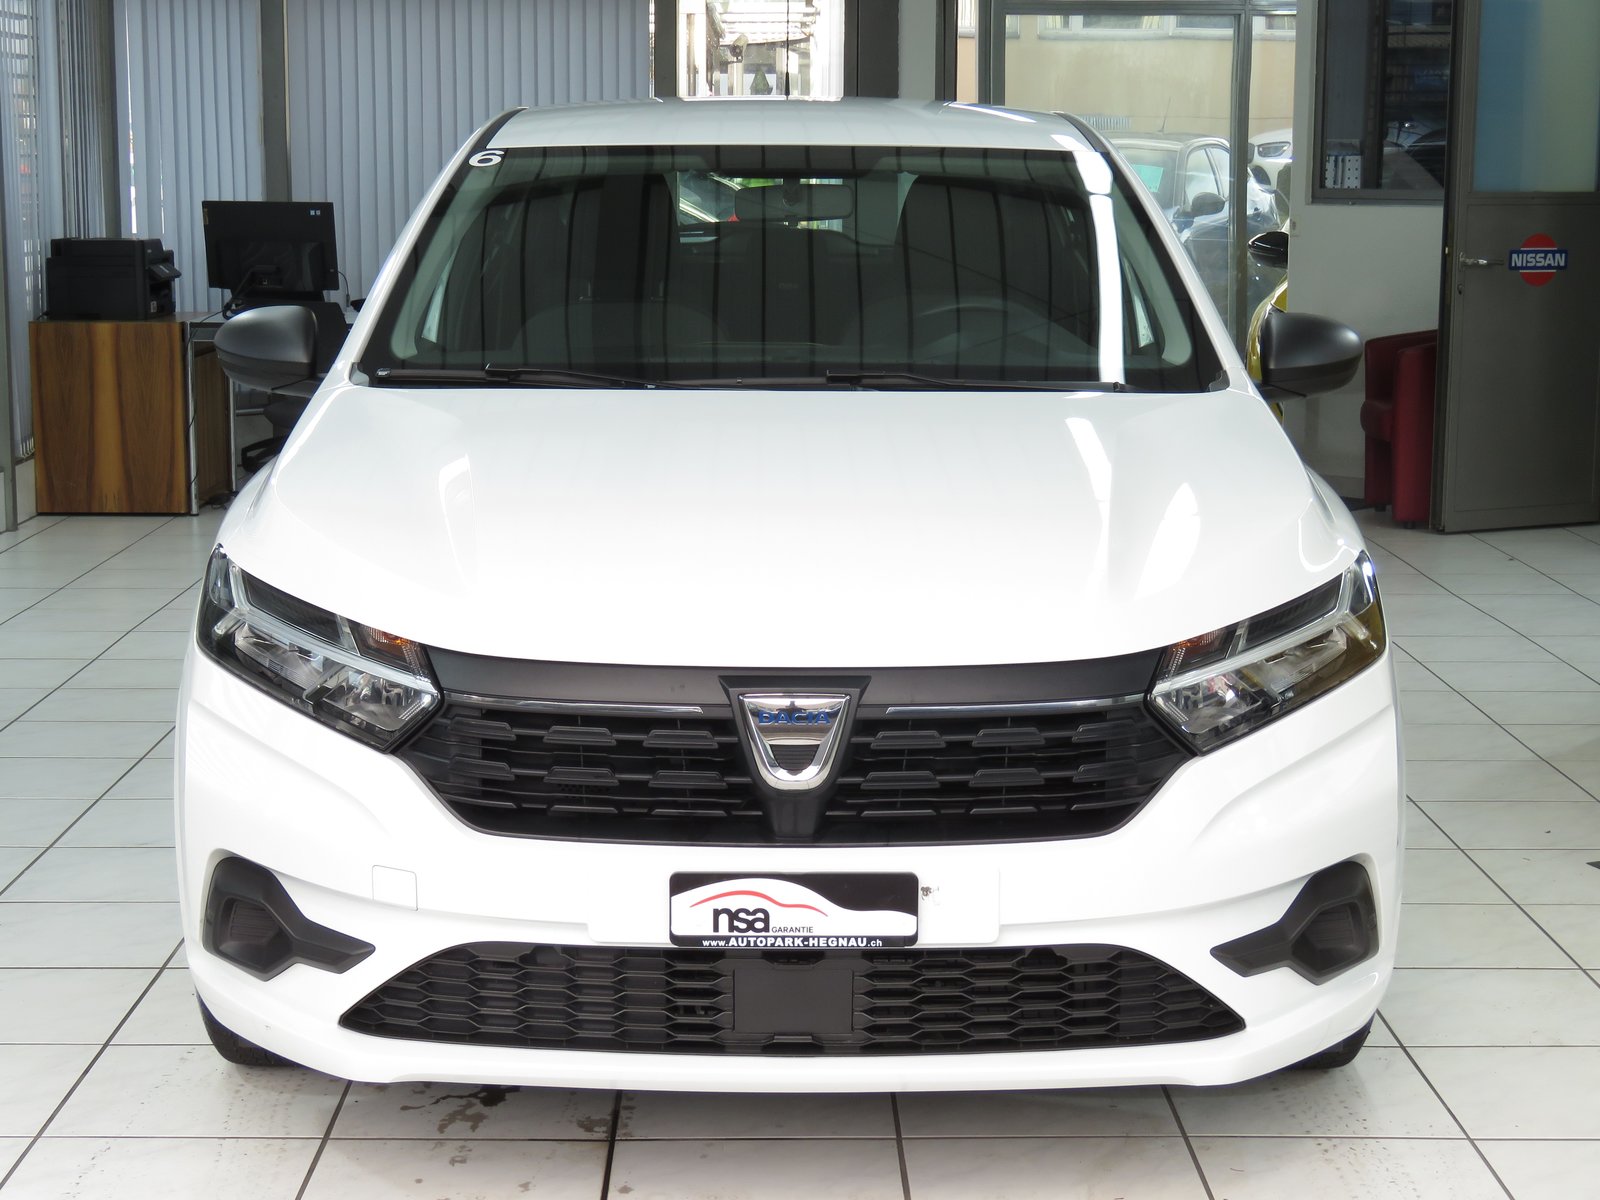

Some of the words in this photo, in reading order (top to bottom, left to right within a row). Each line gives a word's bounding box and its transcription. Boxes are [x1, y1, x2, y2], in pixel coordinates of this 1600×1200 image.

[469, 150, 505, 167] 6
[1511, 253, 1566, 267] NISSAN
[758, 711, 830, 725] DACIA
[713, 908, 770, 933] nsa
[771, 926, 814, 934] GARANTIE
[702, 937, 883, 947] www.AUTOPARK-HEGNAU.ch
